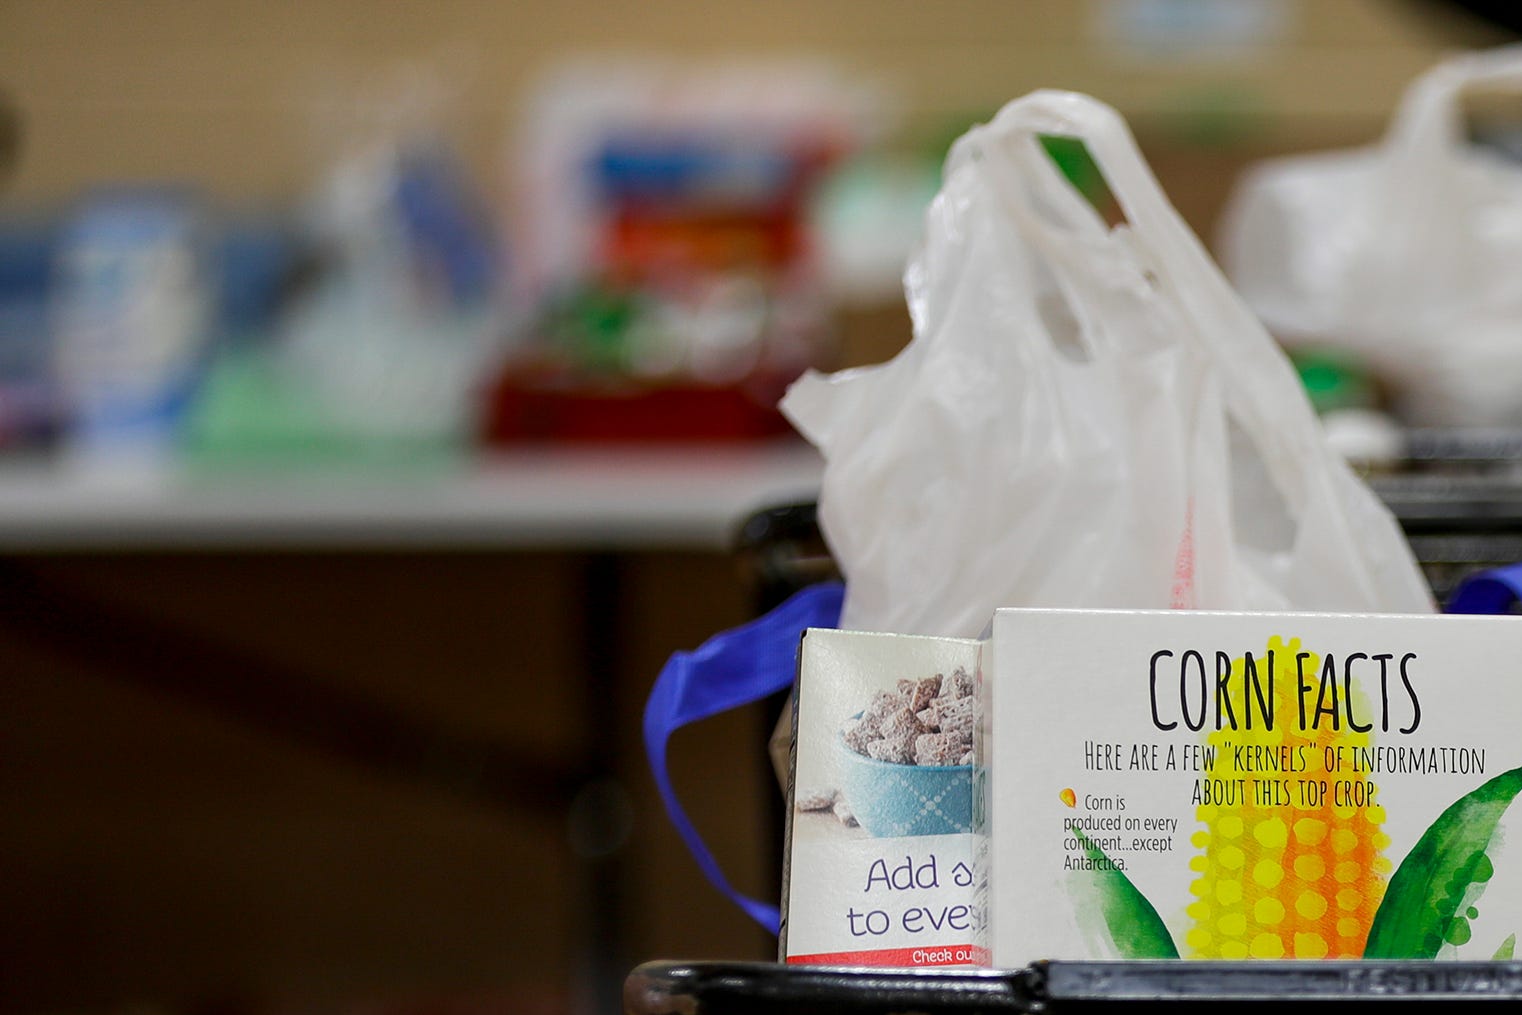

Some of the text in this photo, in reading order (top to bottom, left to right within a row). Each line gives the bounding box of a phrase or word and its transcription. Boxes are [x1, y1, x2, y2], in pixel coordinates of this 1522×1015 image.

[1150, 650, 1421, 734] CORN FACTS
[1085, 741, 1486, 775] HERE ARE A FEW "KERNELS" OF INFORMATION
[1085, 794, 1126, 811] Corn is
[1192, 779, 1381, 808] ABOUT THIS TOP CROP.
[1064, 815, 1178, 833] produced on every
[864, 855, 940, 893] Add
[1063, 855, 1128, 871] Antarctica.
[846, 907, 890, 936] to
[912, 949, 953, 964] Check
